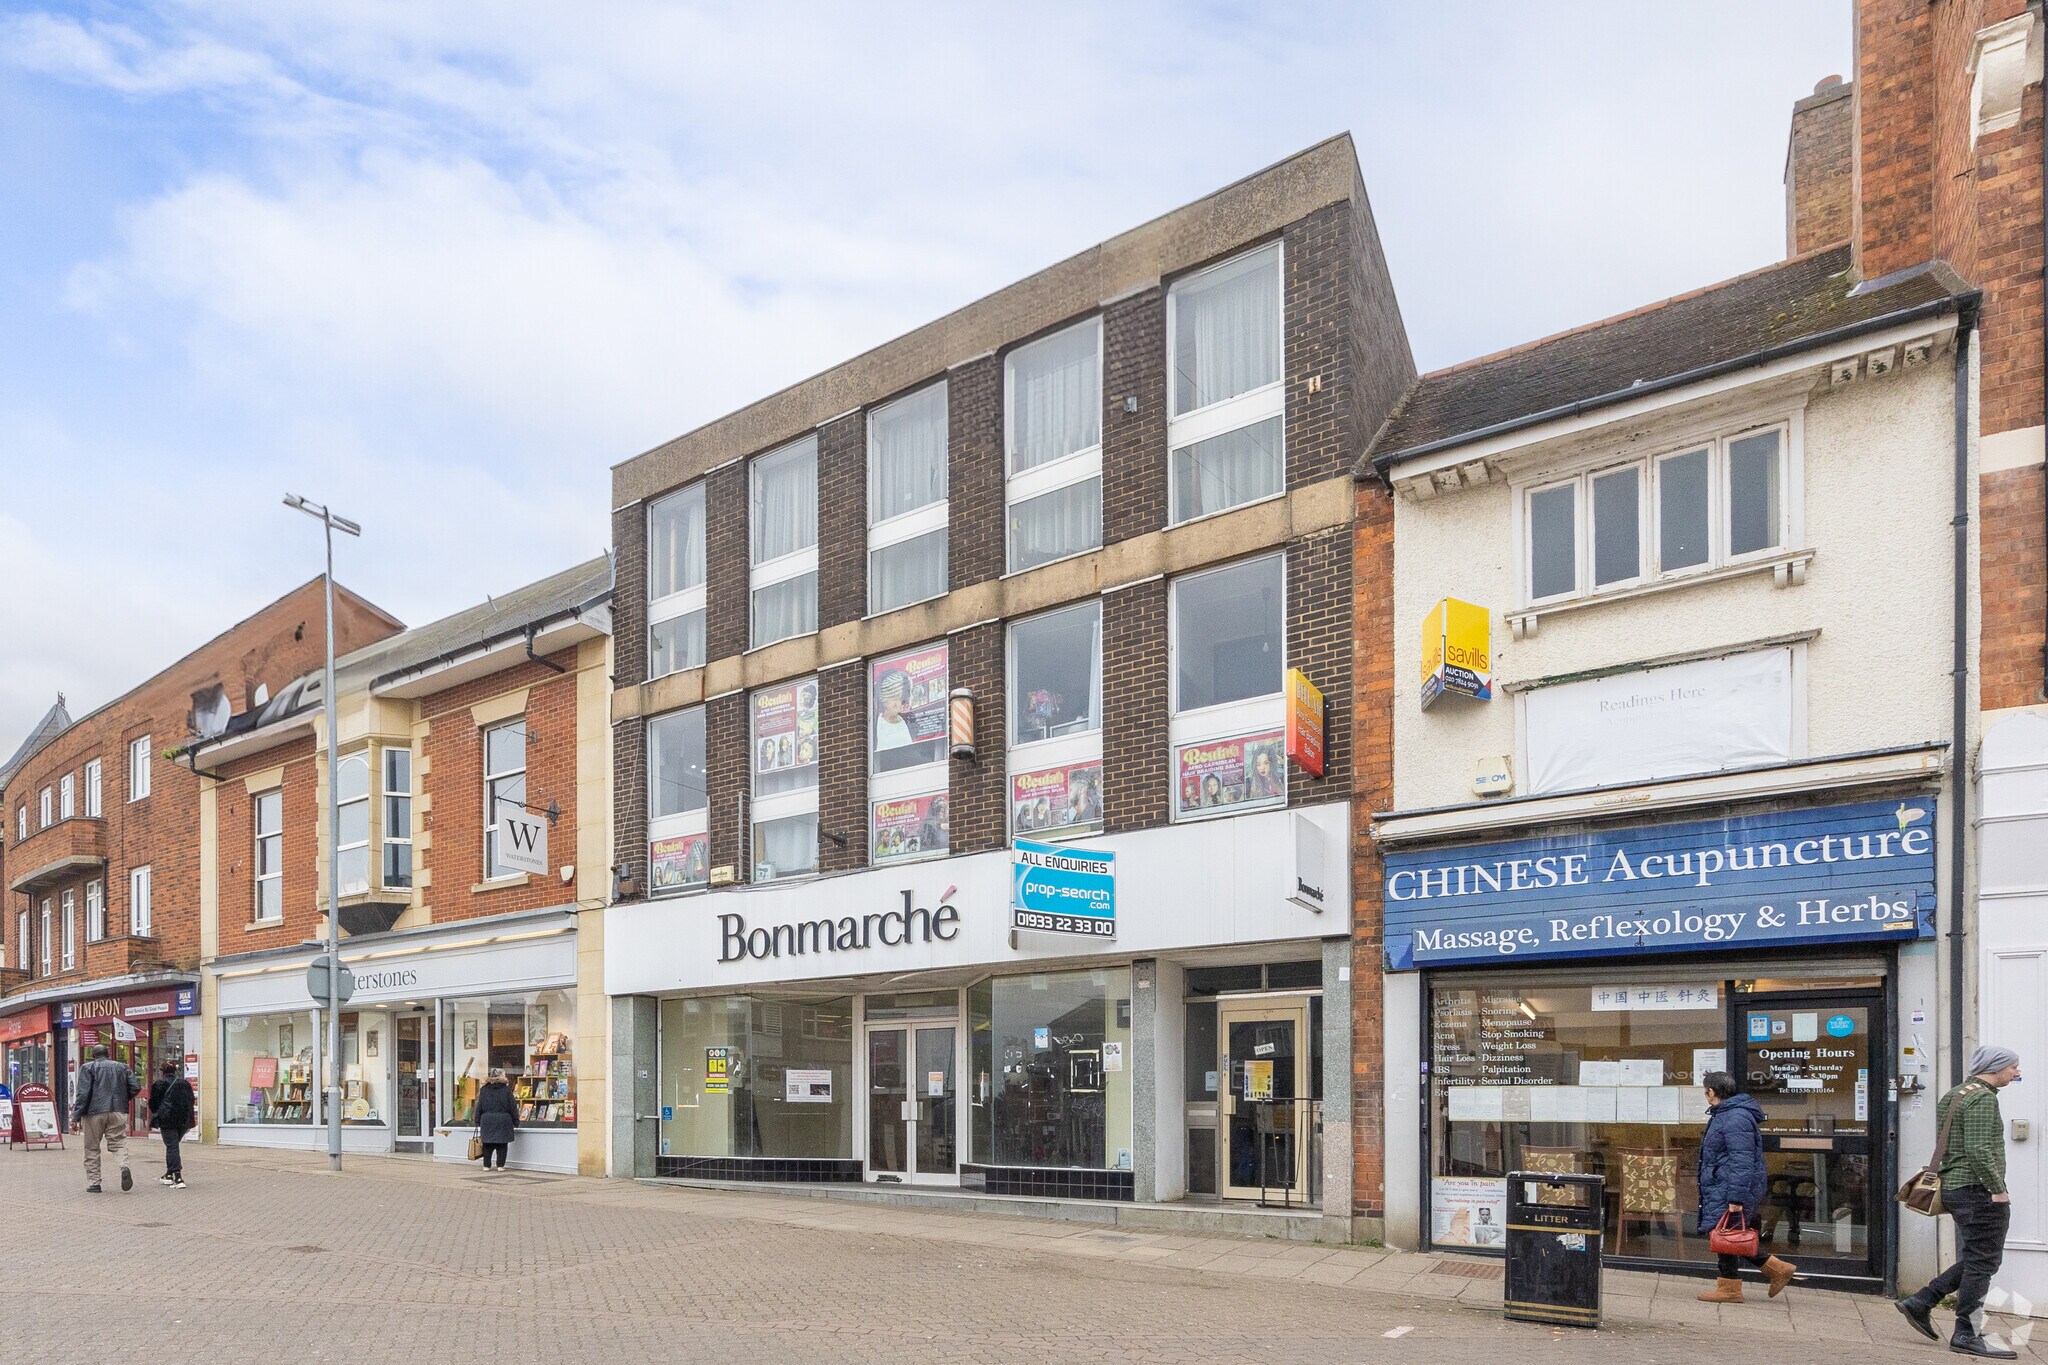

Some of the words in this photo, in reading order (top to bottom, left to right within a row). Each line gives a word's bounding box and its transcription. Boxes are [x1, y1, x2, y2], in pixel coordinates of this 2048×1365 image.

[1448, 645, 1488, 670] savills
[1446, 667, 1474, 680] AUCTION
[1670, 687, 1706, 701] Here
[1183, 744, 1240, 765] Beulah
[1225, 761, 1244, 770] SALON
[1476, 774, 1506, 785] SEOM
[506, 818, 541, 853] W
[505, 852, 543, 866] WATERSTONES
[1021, 852, 1042, 866] ALL
[1045, 856, 1108, 874] ENQUIRIES
[1388, 854, 1589, 901] CHINESE
[1602, 828, 1929, 887] Acupuncture
[1026, 882, 1110, 901] prop-search
[1089, 901, 1110, 910] .com
[717, 884, 960, 963] Bonmarché
[1017, 912, 1053, 930] 01933
[1056, 917, 1072, 931] 22
[1075, 920, 1092, 933] 33
[1095, 921, 1112, 935] 00
[1416, 928, 1540, 954] Massage,
[1549, 911, 1747, 941] Reflexology
[1756, 905, 1785, 928] &
[1796, 896, 1910, 925] Herbs
[353, 969, 417, 990] terstones
[1481, 996, 1522, 1005] Migraine
[1598, 991, 1628, 1005] 中国
[1638, 990, 1669, 1005] 中医
[73, 998, 121, 1020] TIMPSON
[1434, 1008, 1472, 1016] Psoriasis
[1481, 1007, 1517, 1016] Snoring
[1434, 1020, 1467, 1028] Eczema
[1481, 1018, 1532, 1028] Menopause
[1481, 1030, 1502, 1039] Stop
[1504, 1028, 1544, 1039] Smoking
[1256, 1045, 1273, 1053] OPEN
[1434, 1043, 1460, 1051] Stress
[1481, 1041, 1513, 1051] Weight
[1516, 1041, 1537, 1050] Loss
[1434, 1054, 1454, 1062] Hair
[1456, 1054, 1476, 1062] Loss
[1481, 1054, 1524, 1062] Dizziness
[1759, 1048, 1811, 1061] Opening
[1816, 1048, 1855, 1057] Hours
[1434, 1065, 1450, 1074] IBS
[1481, 1065, 1531, 1074] Palpitation
[1434, 1077, 1476, 1086] Infertility
[1481, 1076, 1511, 1085] Sexual
[1514, 1075, 1553, 1085] Disorder
[22, 1087, 49, 1096] TIMPSON
[1534, 1214, 1569, 1224] LITTER
